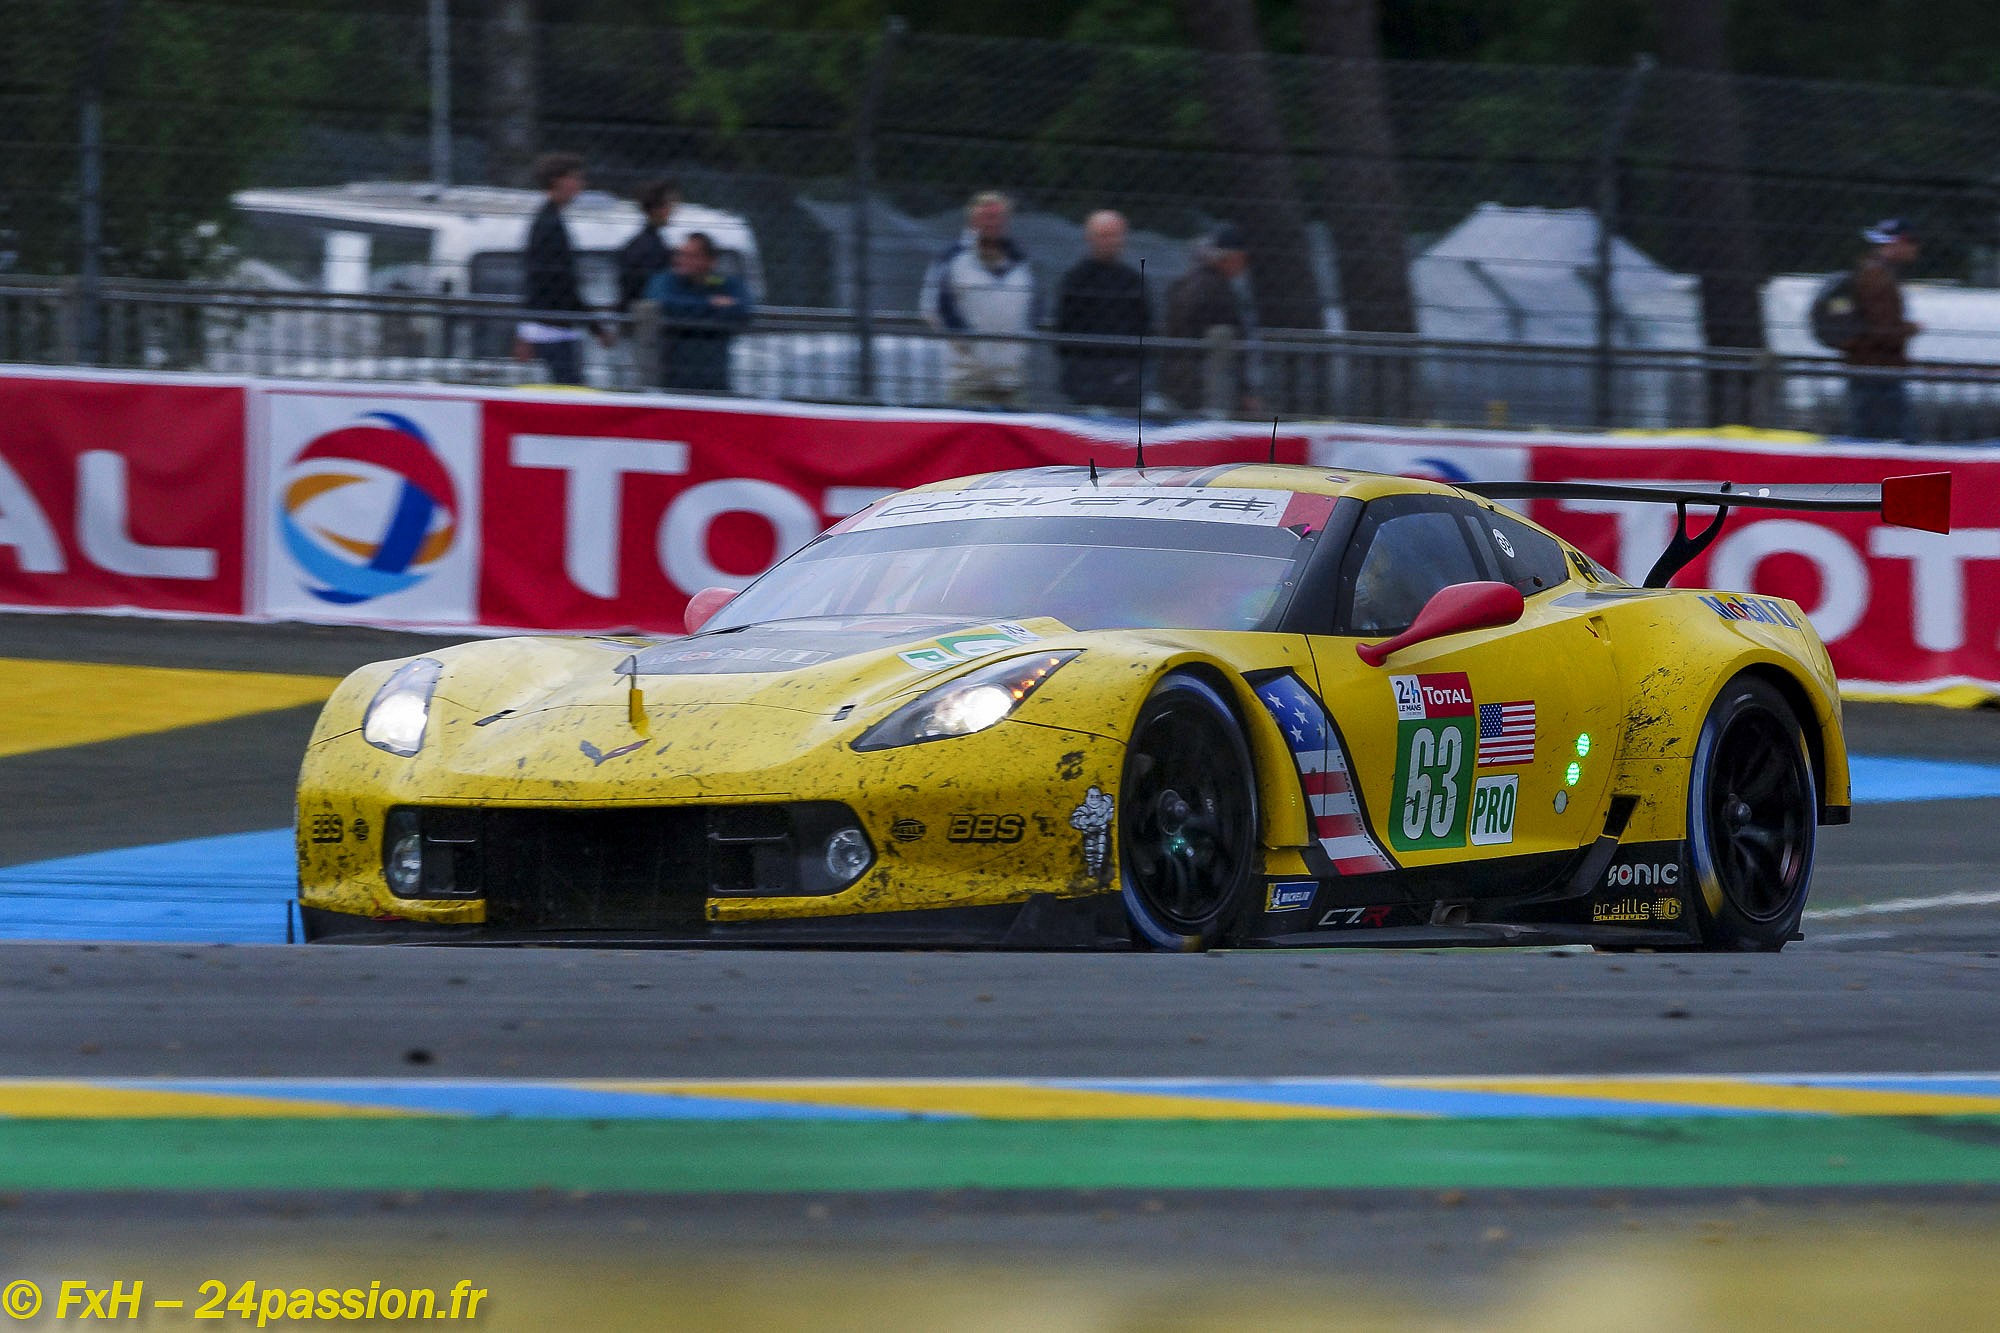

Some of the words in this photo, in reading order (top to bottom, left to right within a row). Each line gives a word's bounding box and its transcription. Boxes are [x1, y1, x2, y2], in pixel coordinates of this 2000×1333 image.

[876, 495, 1278, 519] CORVETTE
[1697, 596, 1779, 625] Mobil
[1396, 680, 1420, 703] 24h
[1423, 686, 1471, 705] TOTAL
[1399, 704, 1406, 712] LE
[1402, 726, 1462, 840] 63
[1472, 784, 1514, 836] PRO
[947, 812, 1026, 843] BBS
[1593, 898, 1650, 915] braille
